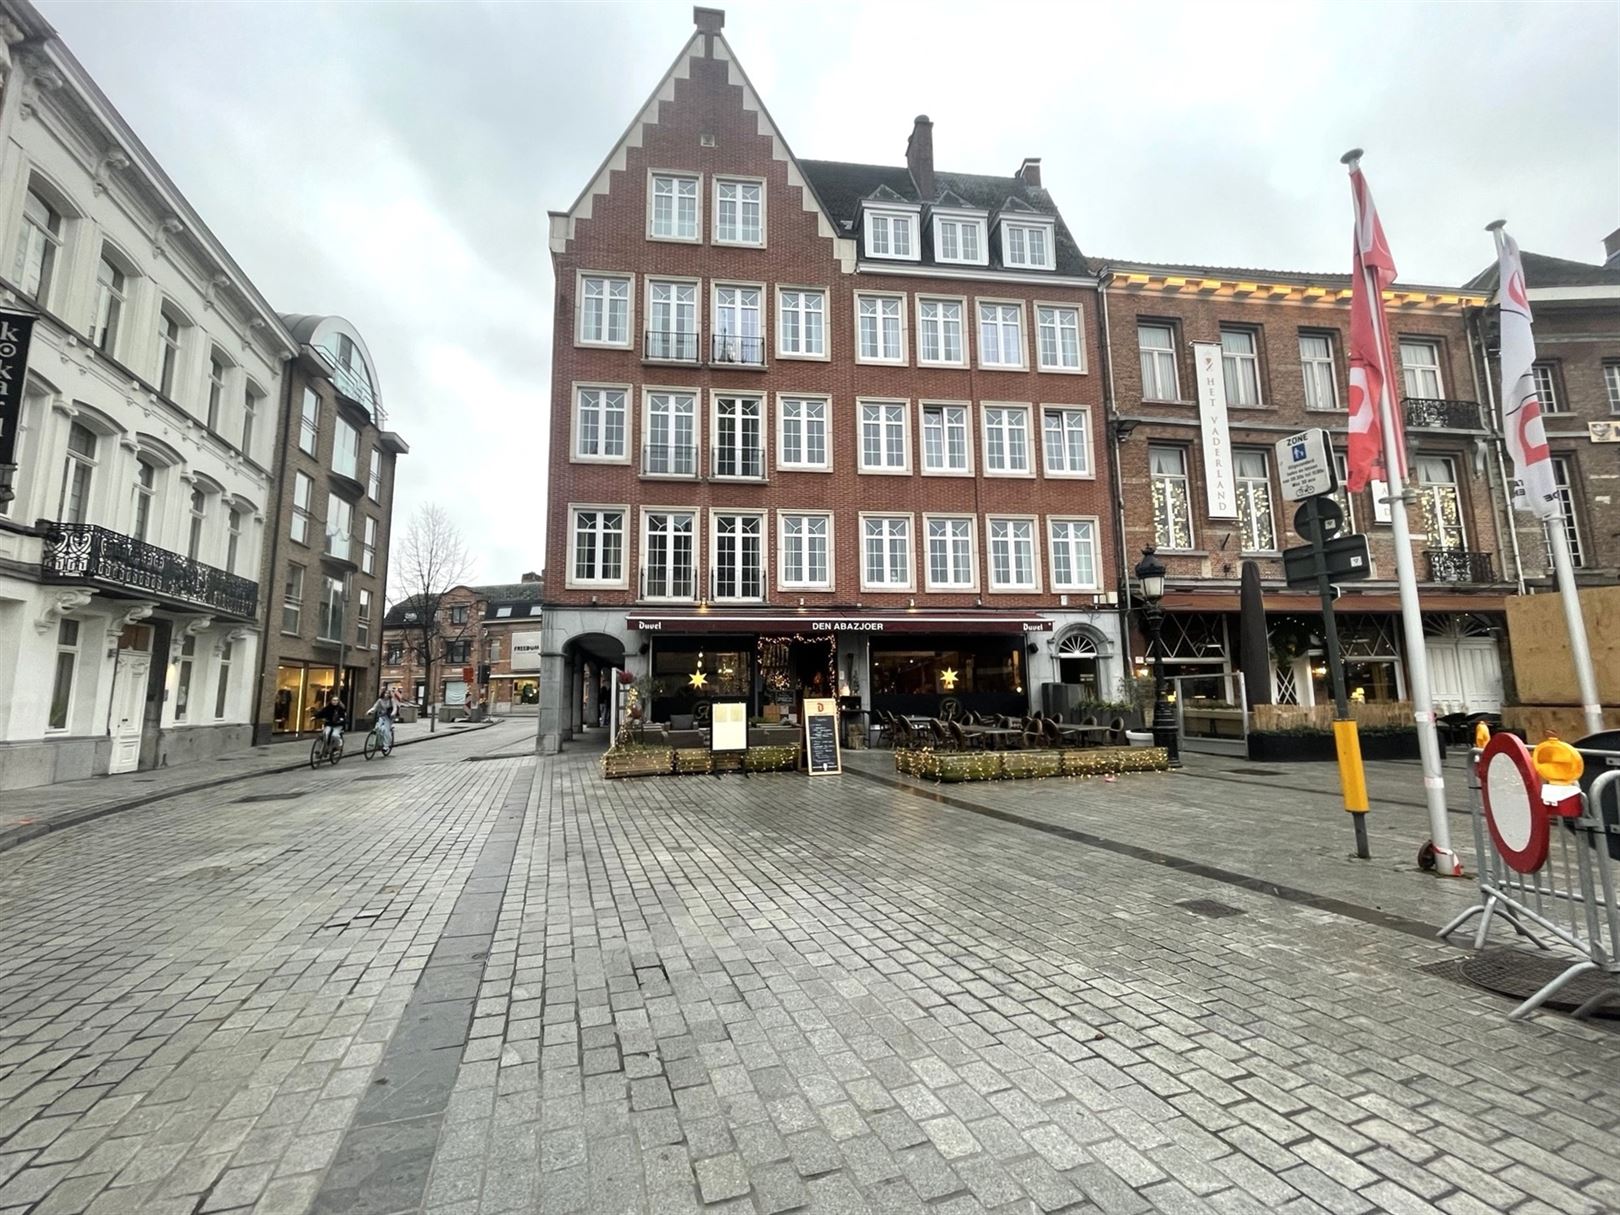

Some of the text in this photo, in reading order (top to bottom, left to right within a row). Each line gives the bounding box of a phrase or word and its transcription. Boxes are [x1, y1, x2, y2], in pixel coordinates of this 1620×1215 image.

[1206, 377, 1228, 511] HET VADERLAND
[1286, 433, 1309, 447] ZONE
[638, 620, 662, 630] Duvel
[812, 622, 884, 631] DEN ABAZJOER
[1023, 622, 1043, 631] Duvel
